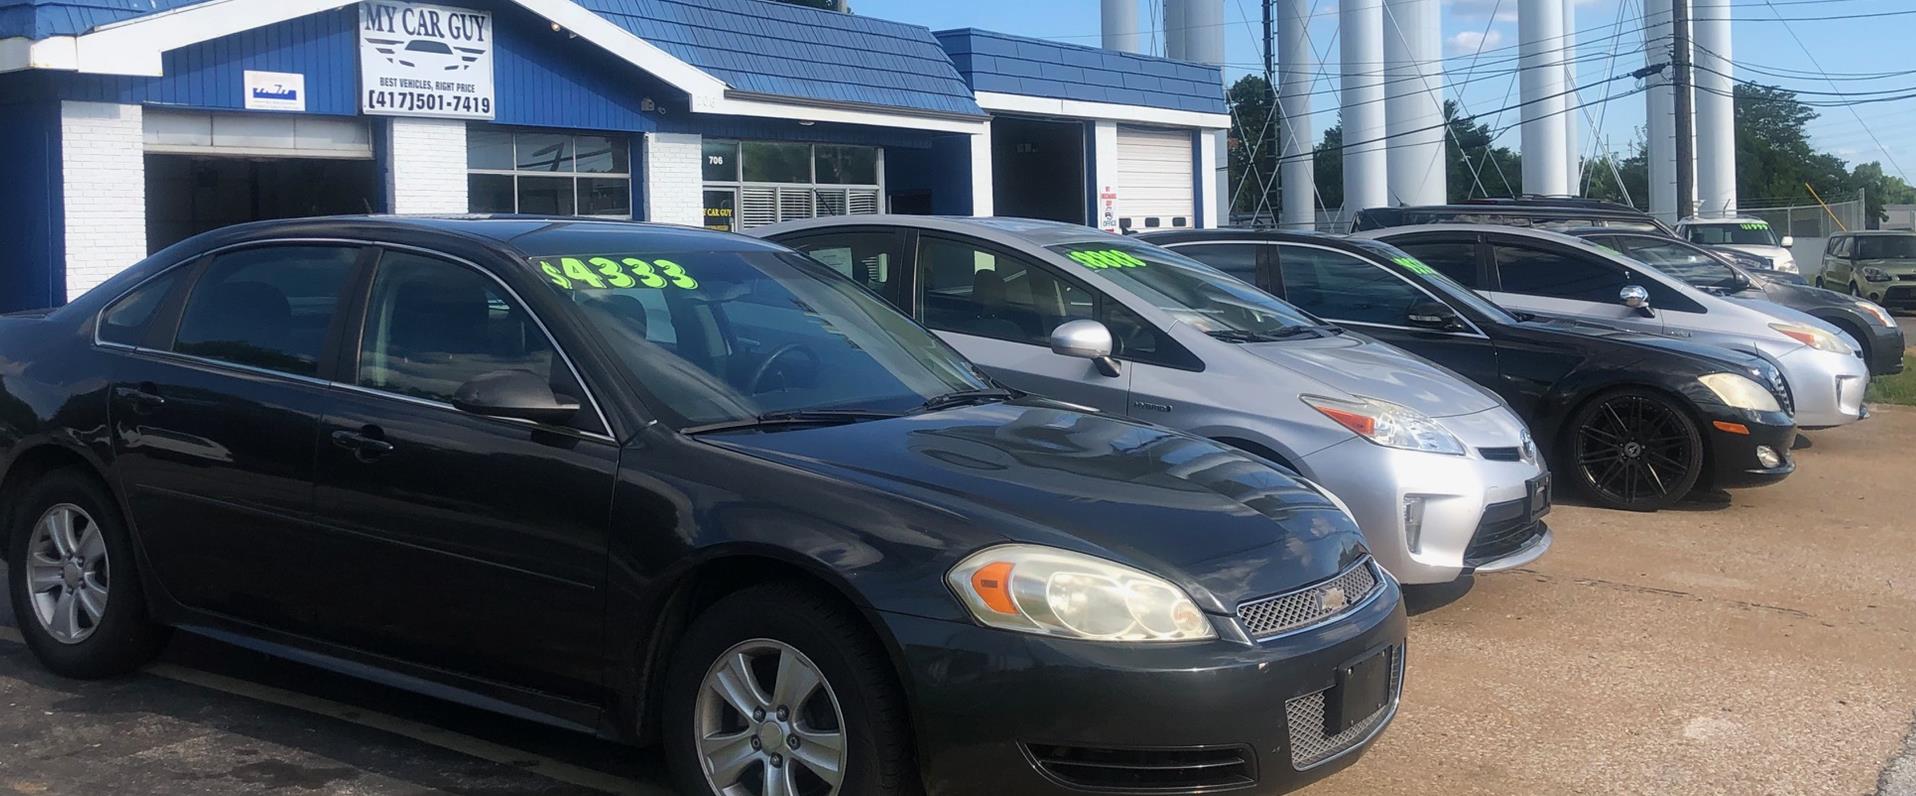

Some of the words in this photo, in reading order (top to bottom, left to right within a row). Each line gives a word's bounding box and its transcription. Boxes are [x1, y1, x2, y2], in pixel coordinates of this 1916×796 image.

[365, 3, 397, 33] MY
[402, 8, 445, 39] CAR
[448, 13, 487, 42] GUY
[380, 77, 398, 88] BEST
[399, 79, 434, 91] VEHICLES,
[435, 81, 455, 92] RIGHT
[456, 83, 476, 93] PRICE
[708, 155, 723, 165] 706
[707, 208, 719, 216] CAR
[719, 208, 733, 217] GUY
[540, 256, 699, 290] $4333
